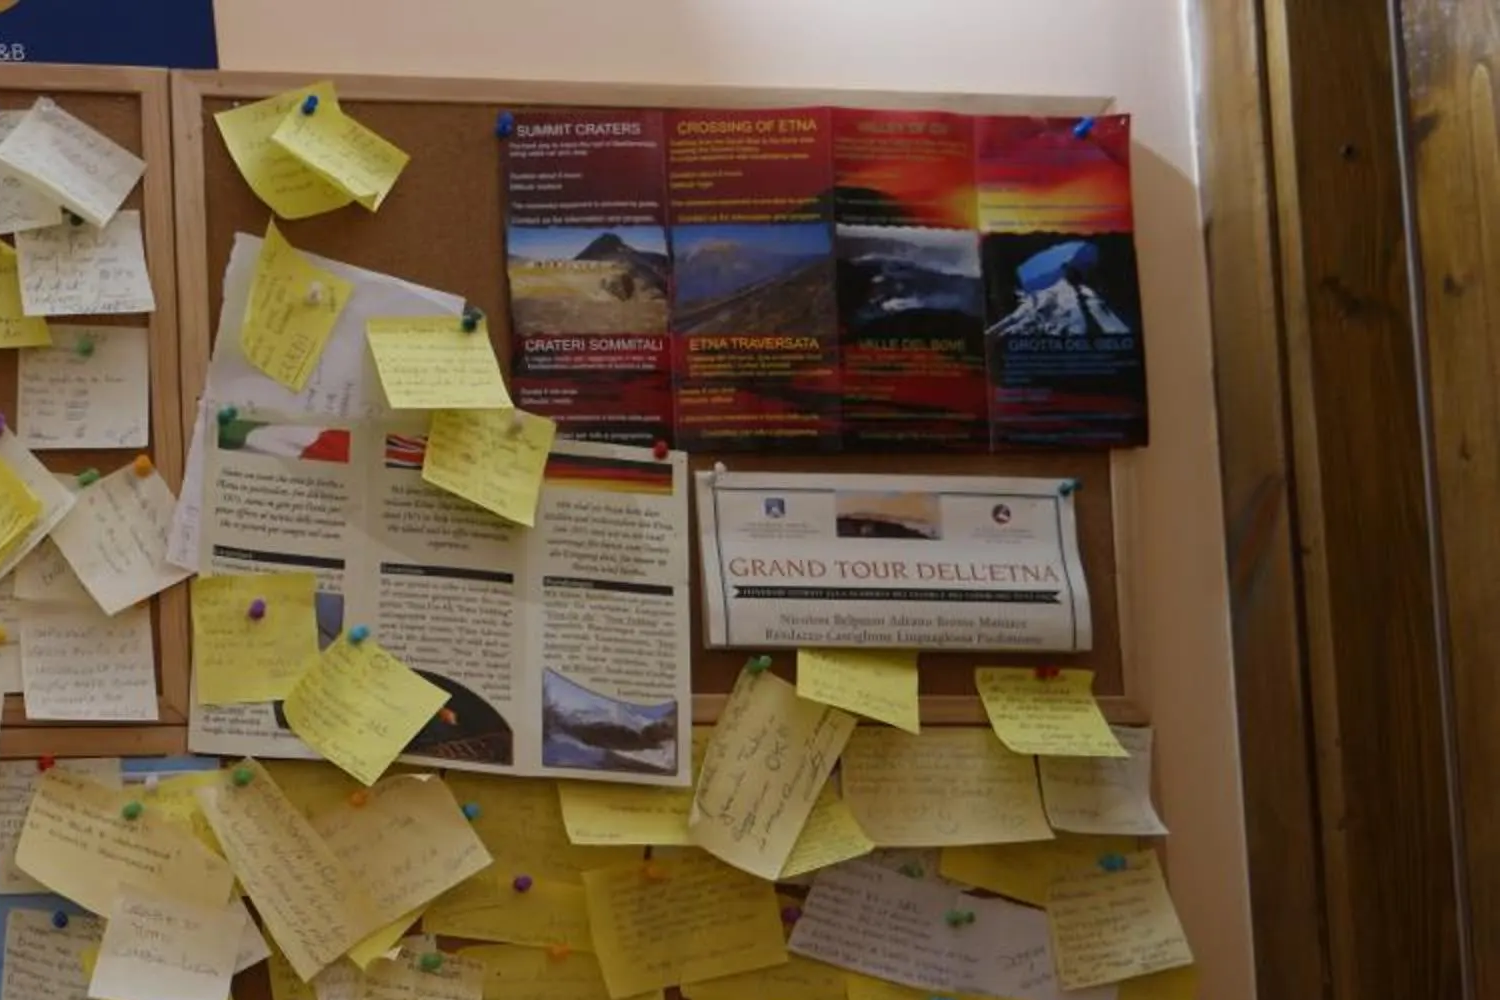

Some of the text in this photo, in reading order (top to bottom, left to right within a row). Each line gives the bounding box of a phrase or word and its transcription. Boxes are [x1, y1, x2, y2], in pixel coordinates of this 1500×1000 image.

[517, 122, 641, 137] SUMMIT CRATERS
[677, 119, 817, 135] CROSSING OF ETNA
[525, 338, 663, 352] CRATERI SOMMITALI
[689, 337, 820, 351] ETNA TRAVERSATA
[729, 557, 1060, 584] GRAND TOUR DELL'ETNA
